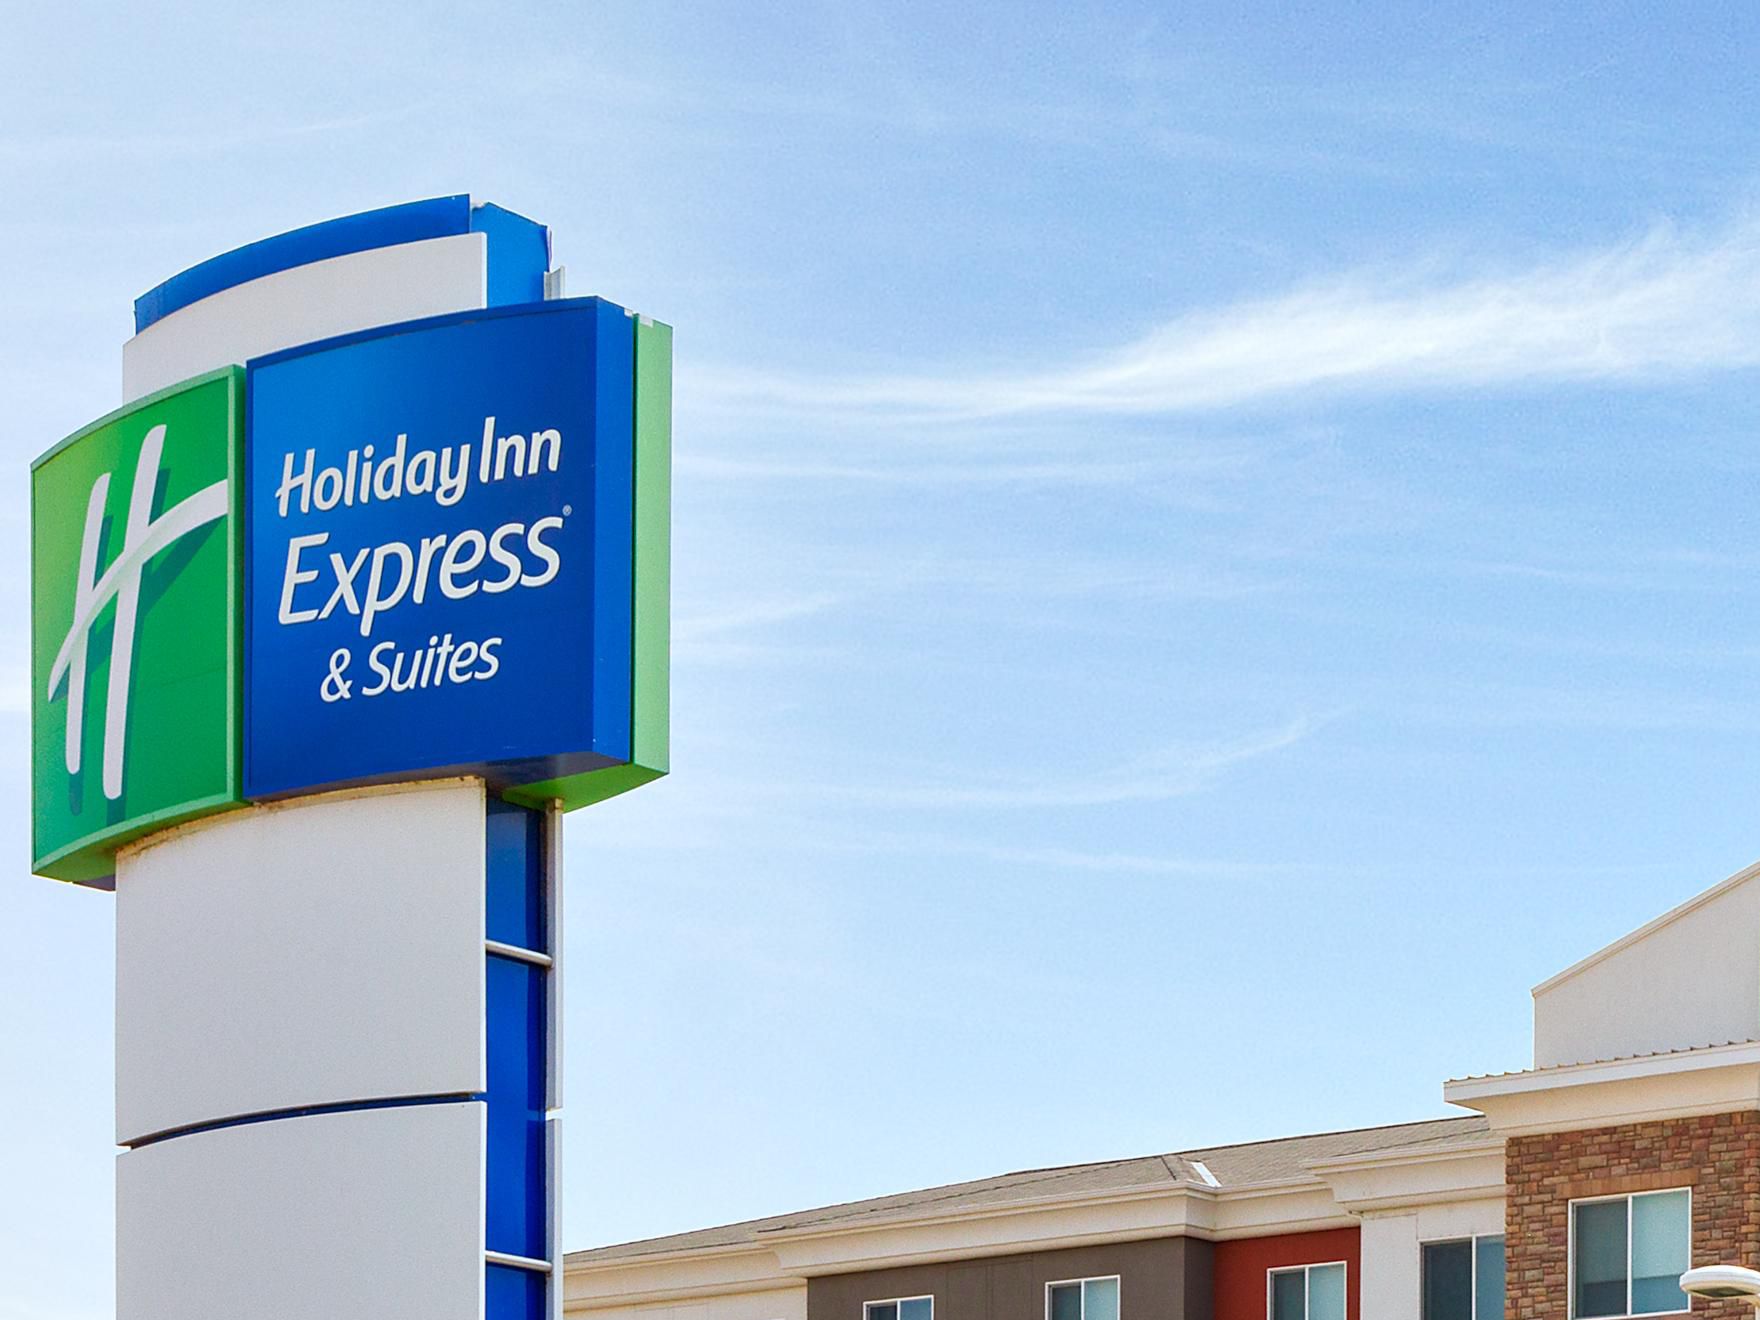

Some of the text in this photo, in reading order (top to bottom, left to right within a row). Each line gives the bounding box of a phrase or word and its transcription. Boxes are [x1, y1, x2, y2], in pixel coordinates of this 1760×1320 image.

[275, 416, 562, 518] Holiday Inn
[320, 633, 502, 702] & Suites
